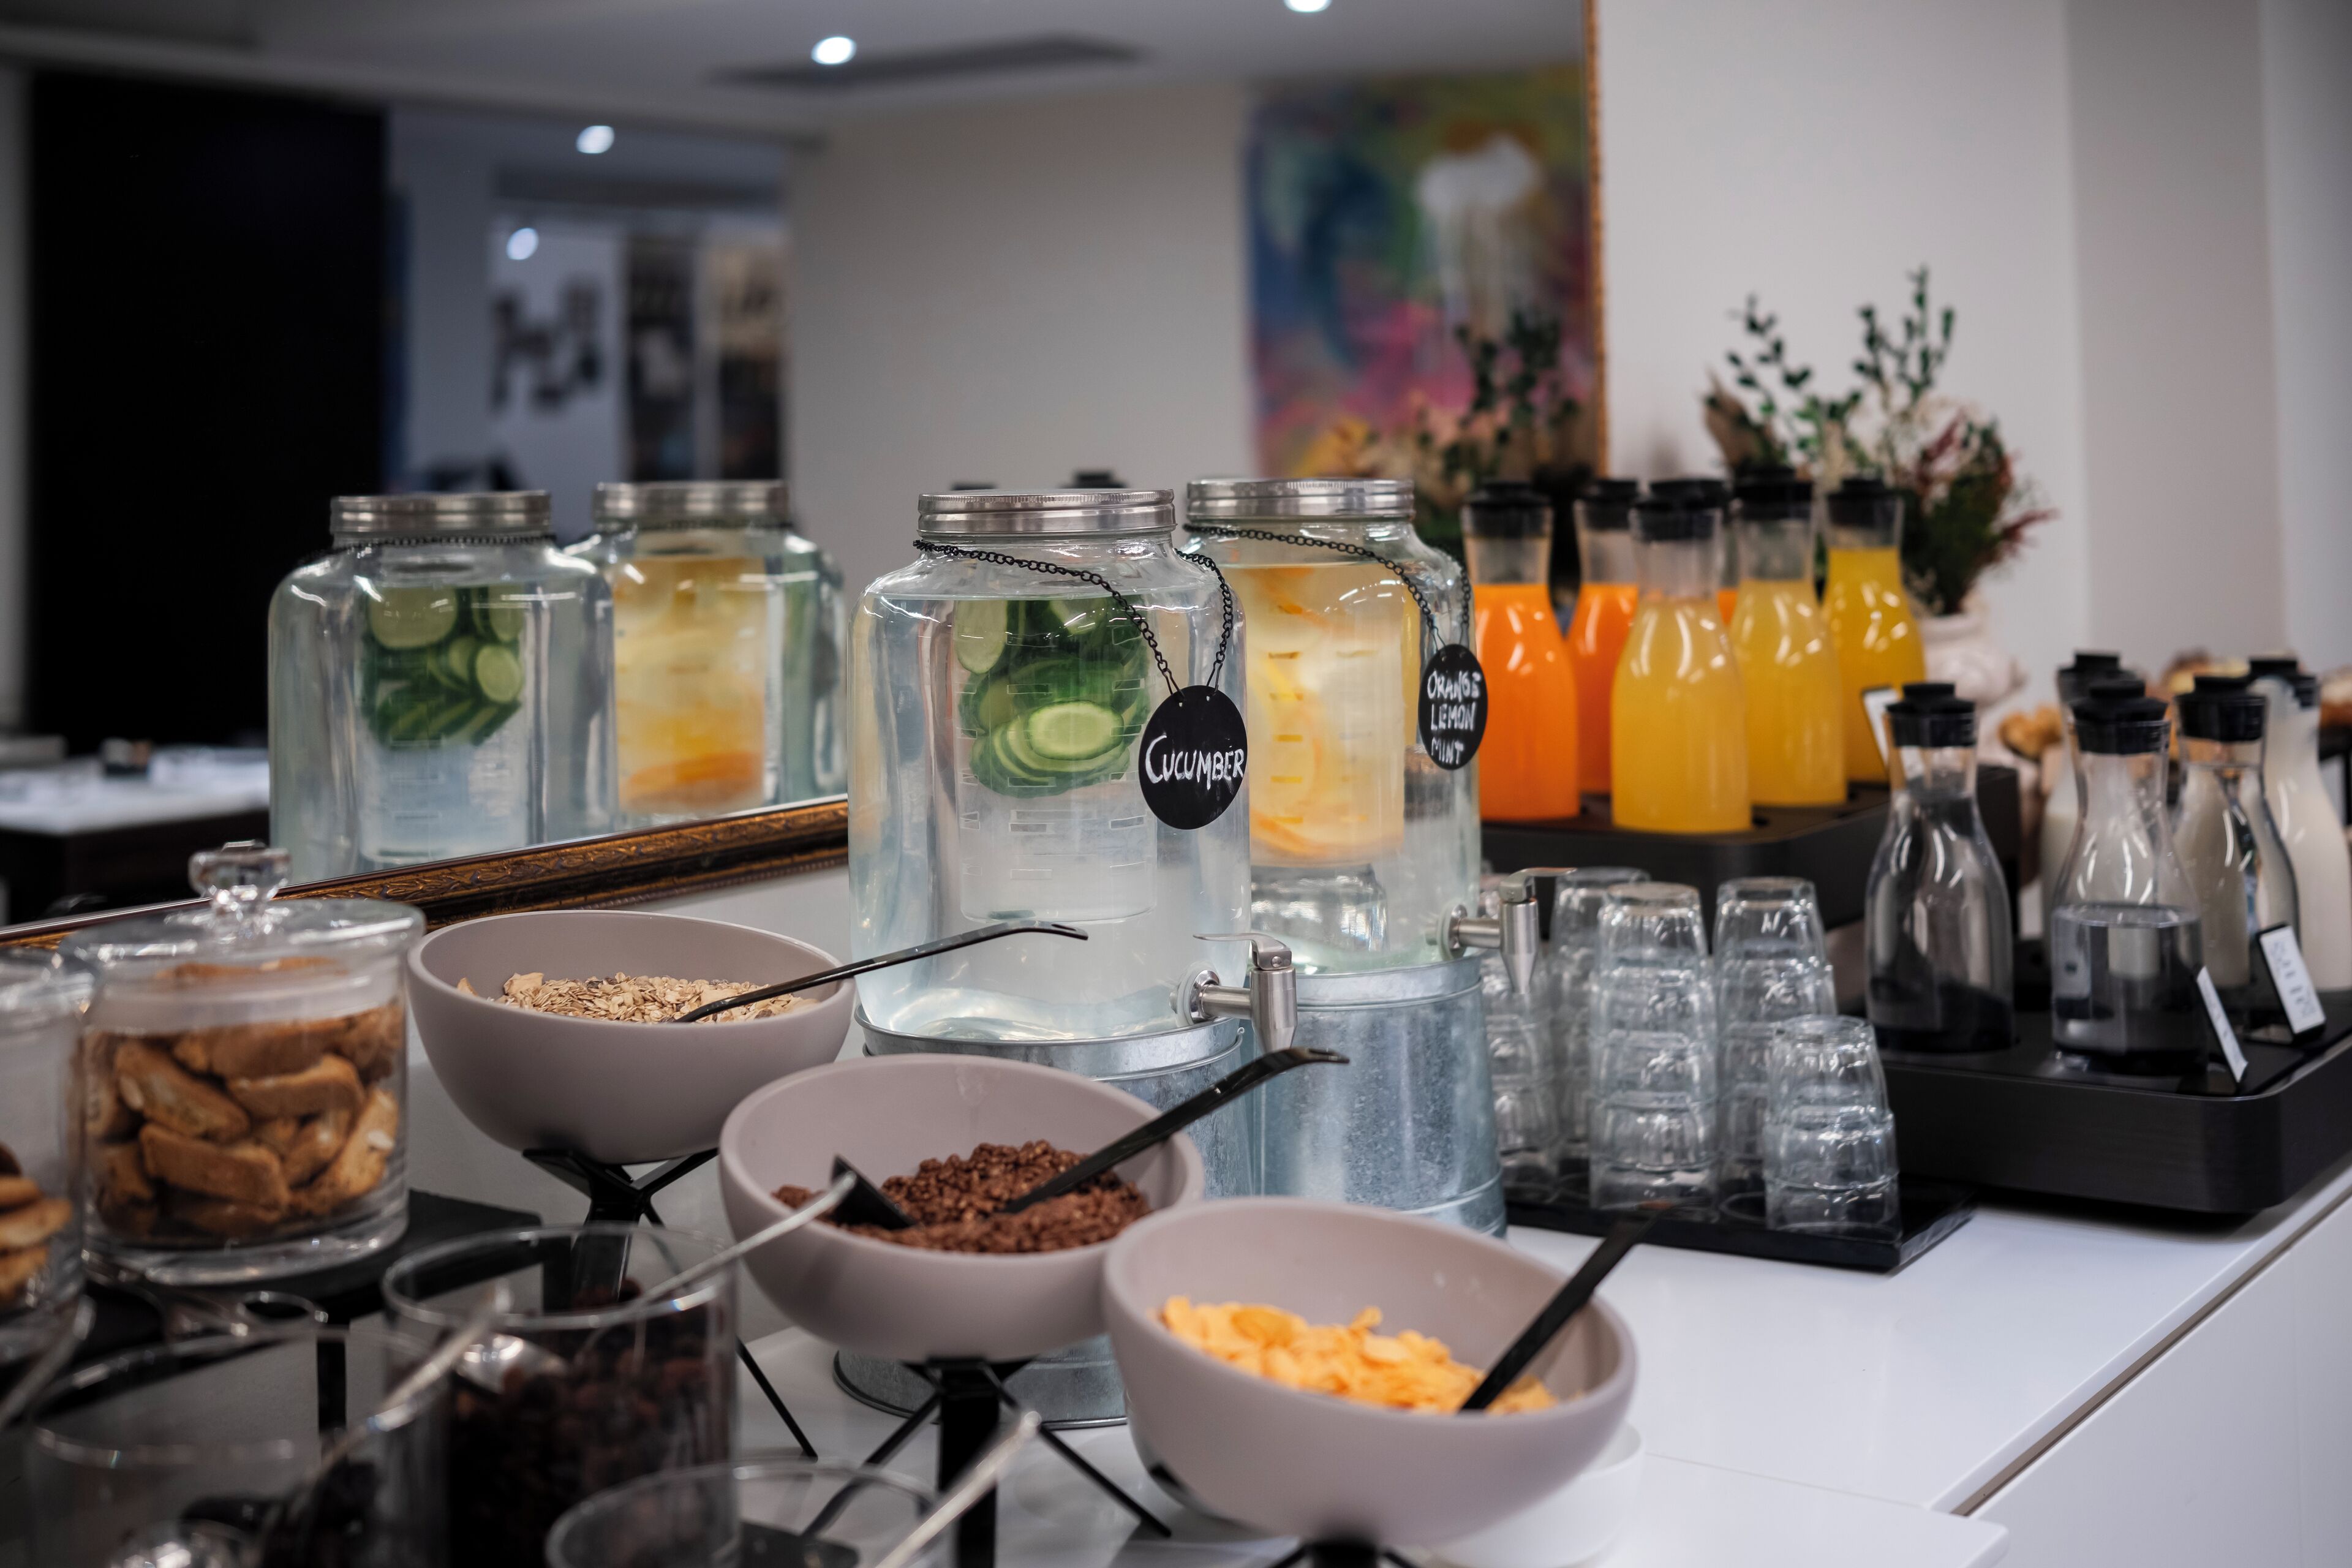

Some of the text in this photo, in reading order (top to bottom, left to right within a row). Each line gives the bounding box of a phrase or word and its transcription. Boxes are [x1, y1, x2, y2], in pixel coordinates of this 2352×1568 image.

[1427, 671, 1482, 702] ORANGE
[1431, 702, 1476, 731] LEMON
[1145, 735, 1244, 790] CUCUMBER
[1431, 737, 1464, 764] MINT
